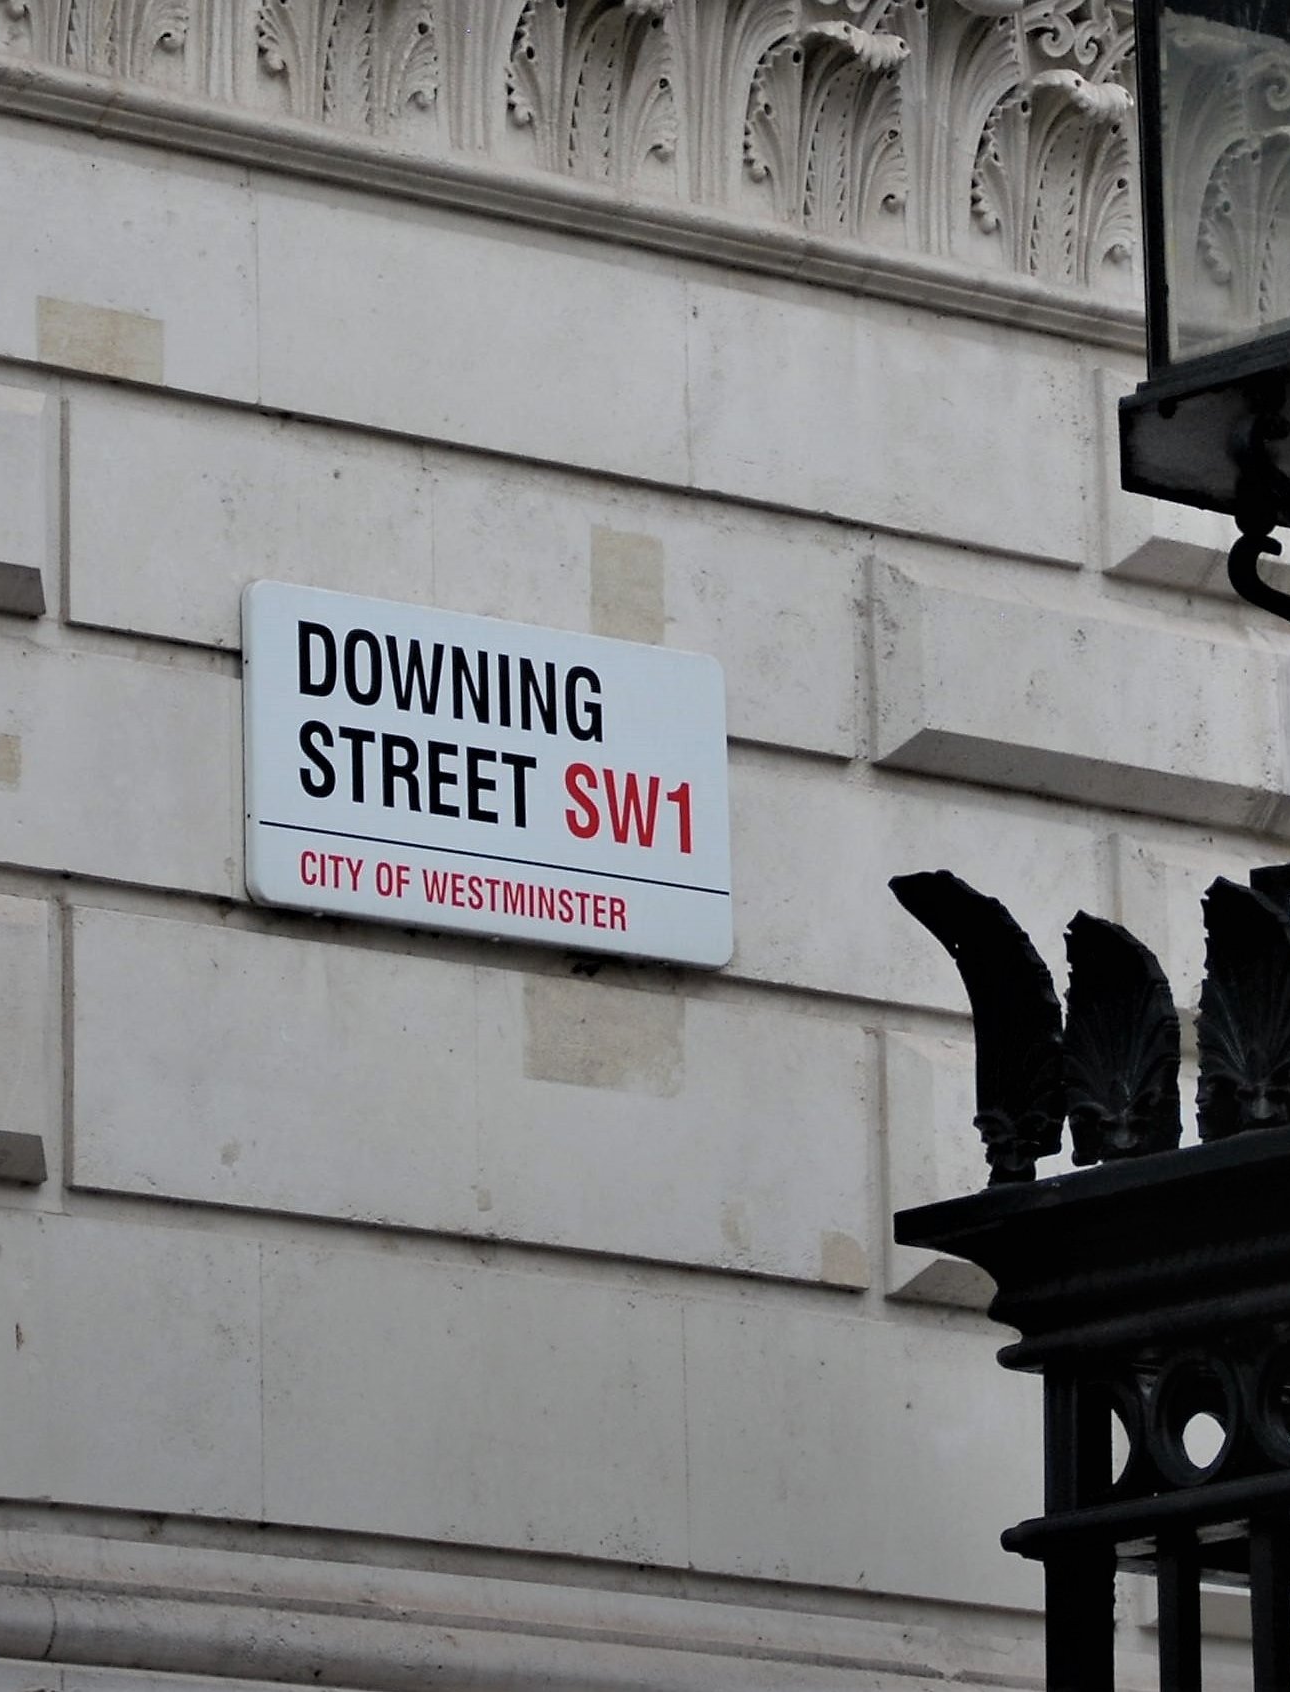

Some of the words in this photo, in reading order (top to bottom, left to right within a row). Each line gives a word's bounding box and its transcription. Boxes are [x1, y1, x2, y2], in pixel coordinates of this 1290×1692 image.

[297, 620, 603, 743] DOWNING
[298, 719, 537, 829] STREET
[564, 762, 692, 854] SW1
[300, 850, 363, 892] CITY
[375, 861, 411, 898] OF
[422, 868, 627, 932] WESTMINSTER
